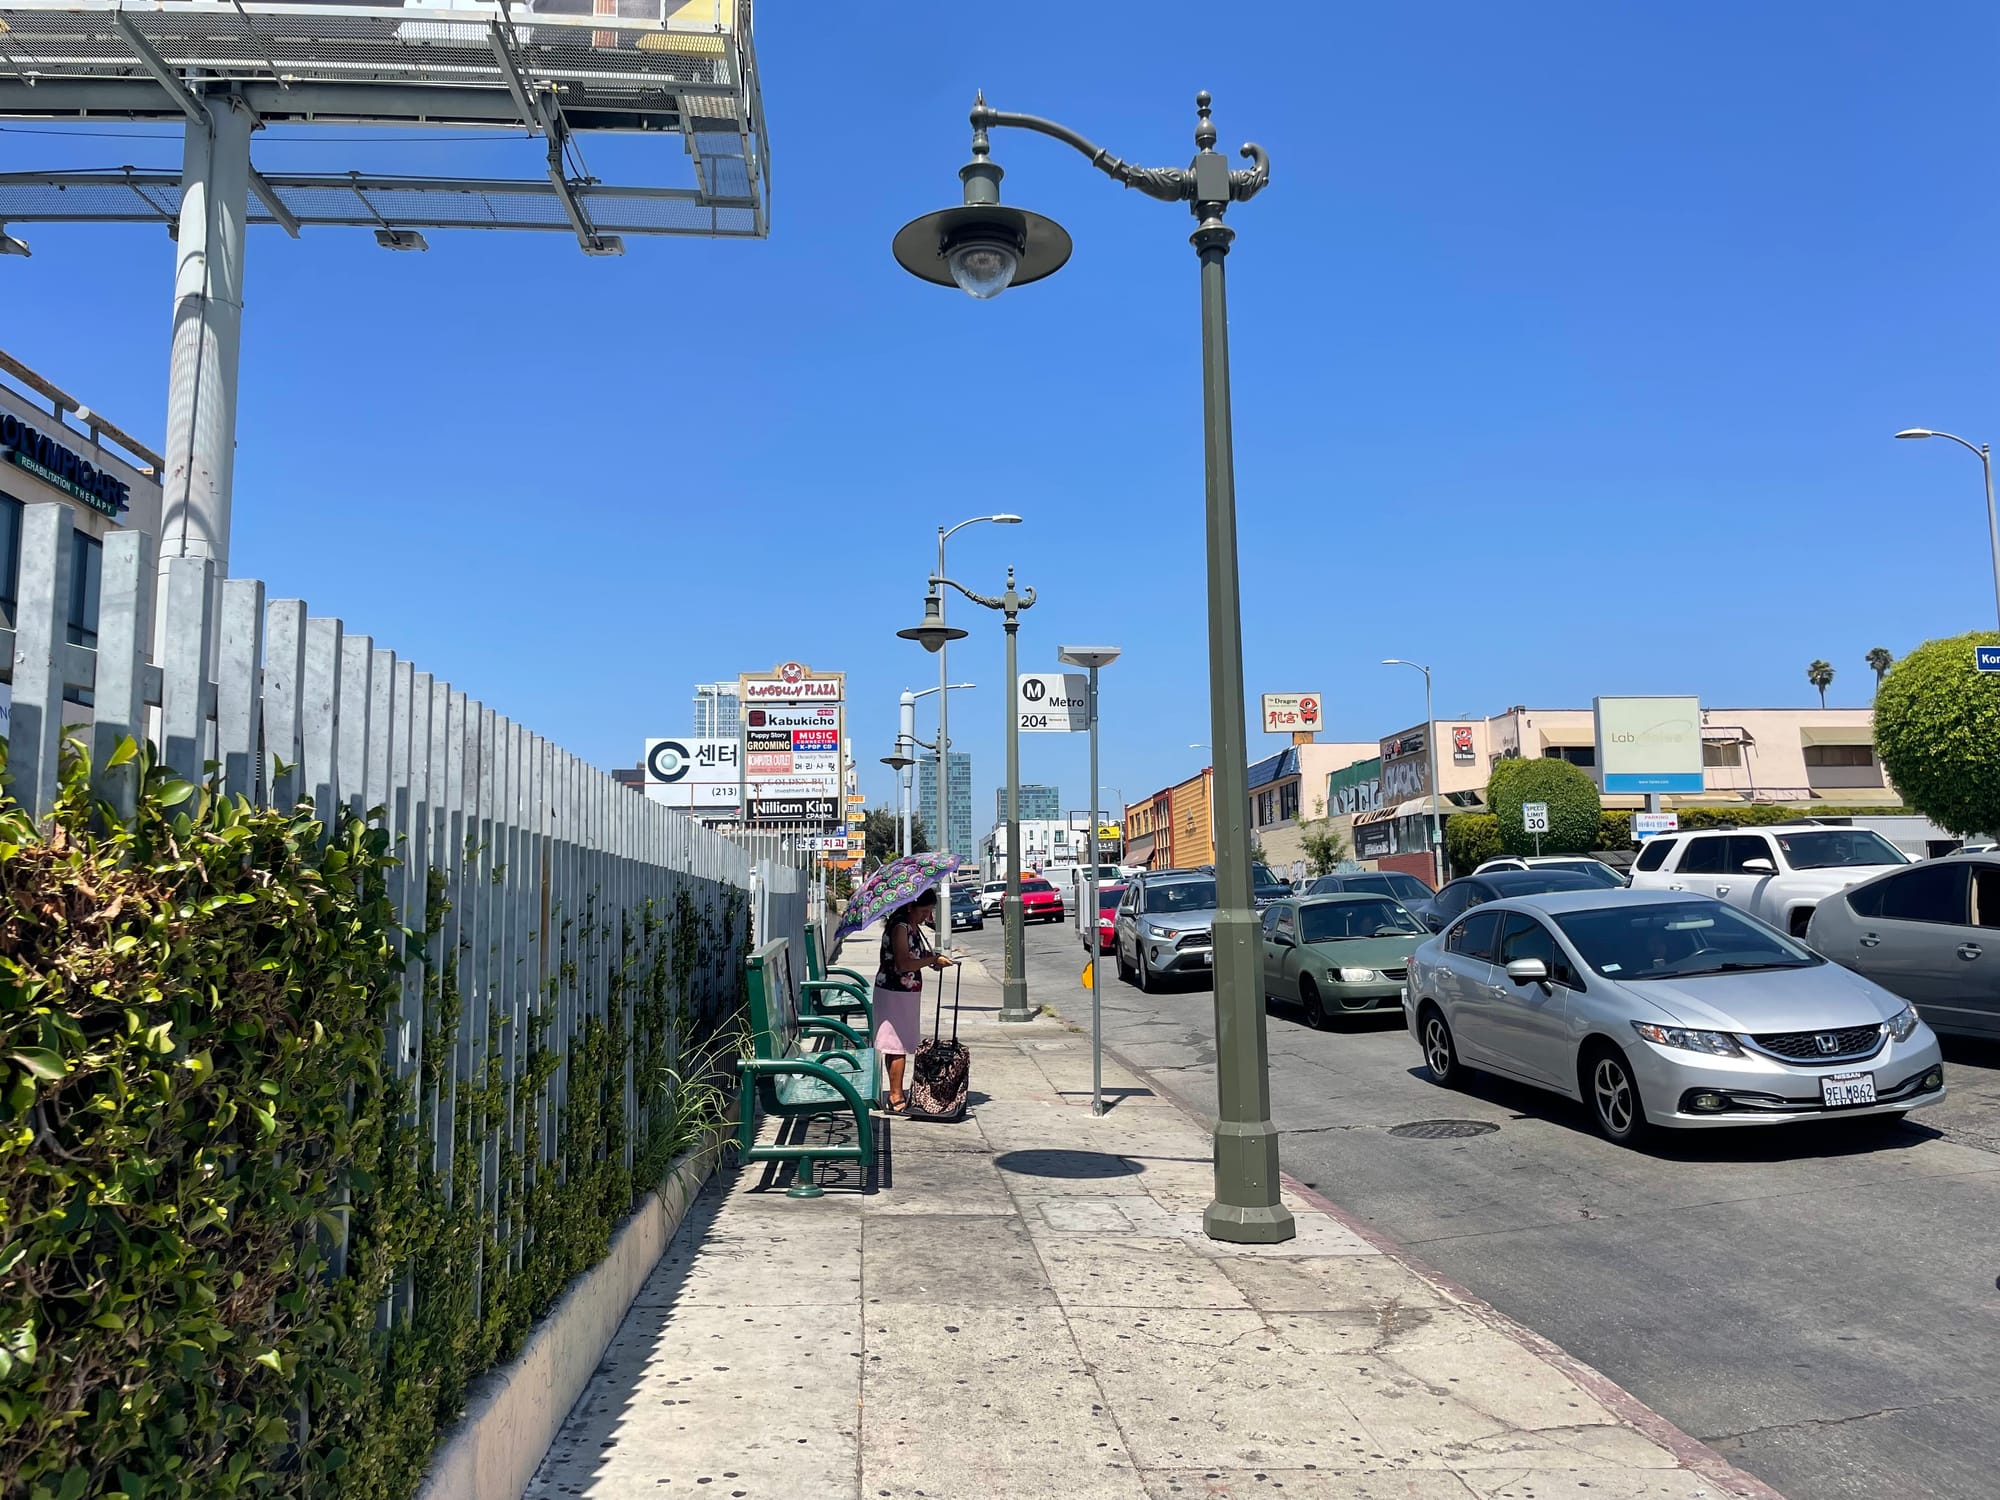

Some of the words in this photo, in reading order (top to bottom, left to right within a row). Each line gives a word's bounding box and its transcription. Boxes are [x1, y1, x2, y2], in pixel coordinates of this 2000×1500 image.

[21, 456, 71, 491] REHABILITATION
[75, 487, 112, 513] THERAPY
[804, 683, 836, 696] PLAZA
[1049, 697, 1084, 707] Metro
[768, 714, 835, 726] Kabukicho
[1021, 715, 1047, 728] 204
[750, 732, 769, 740] Puppy
[770, 732, 787, 740] Story
[799, 731, 833, 740] MUSIC
[747, 741, 791, 751] GROOMING
[695, 744, 737, 767] 센터
[711, 787, 737, 797] (213)
[753, 801, 803, 814] William
[805, 800, 833, 813] Kim
[1528, 819, 1545, 829] 30
[1834, 1072, 1861, 1080] NISSAN
[1825, 1083, 1873, 1101] 9ELM862
[1825, 1098, 1851, 1106] COSTA
